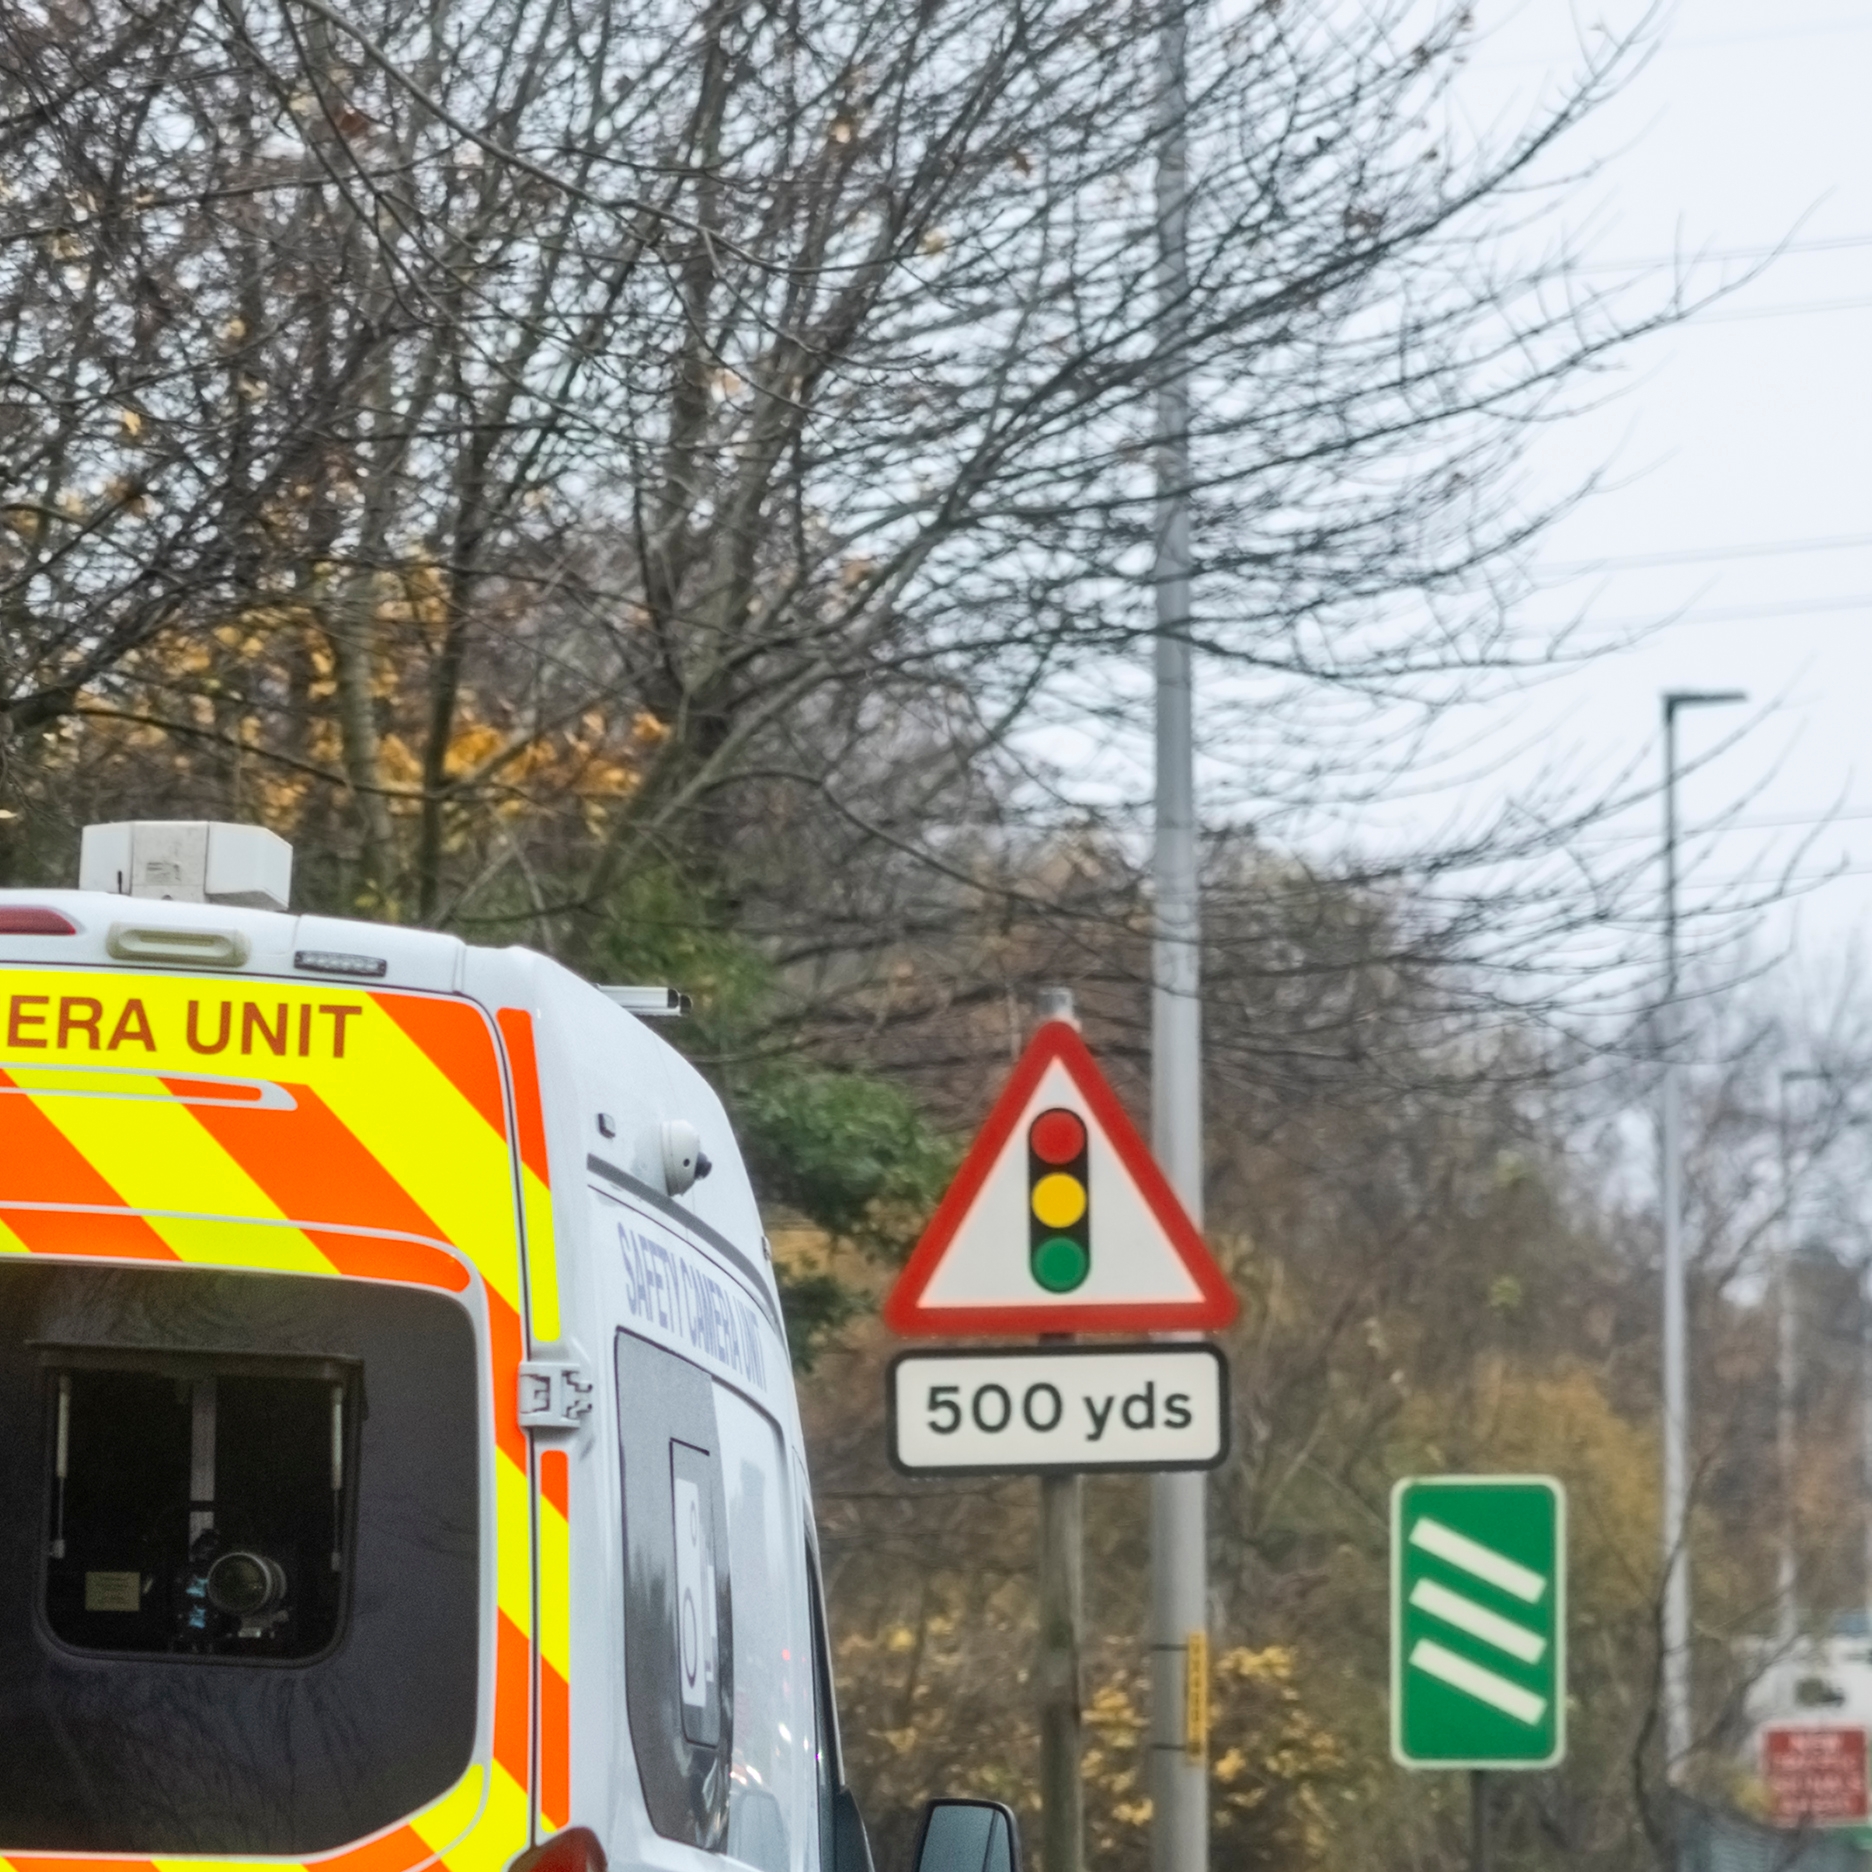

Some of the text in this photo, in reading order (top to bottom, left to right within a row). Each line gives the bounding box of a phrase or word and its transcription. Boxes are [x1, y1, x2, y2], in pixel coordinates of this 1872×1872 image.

[185, 999, 364, 1059] UNIT
[617, 1221, 684, 1339] SAFETY
[680, 1256, 744, 1376] CAMERA
[925, 1380, 1193, 1442] 500 yds
